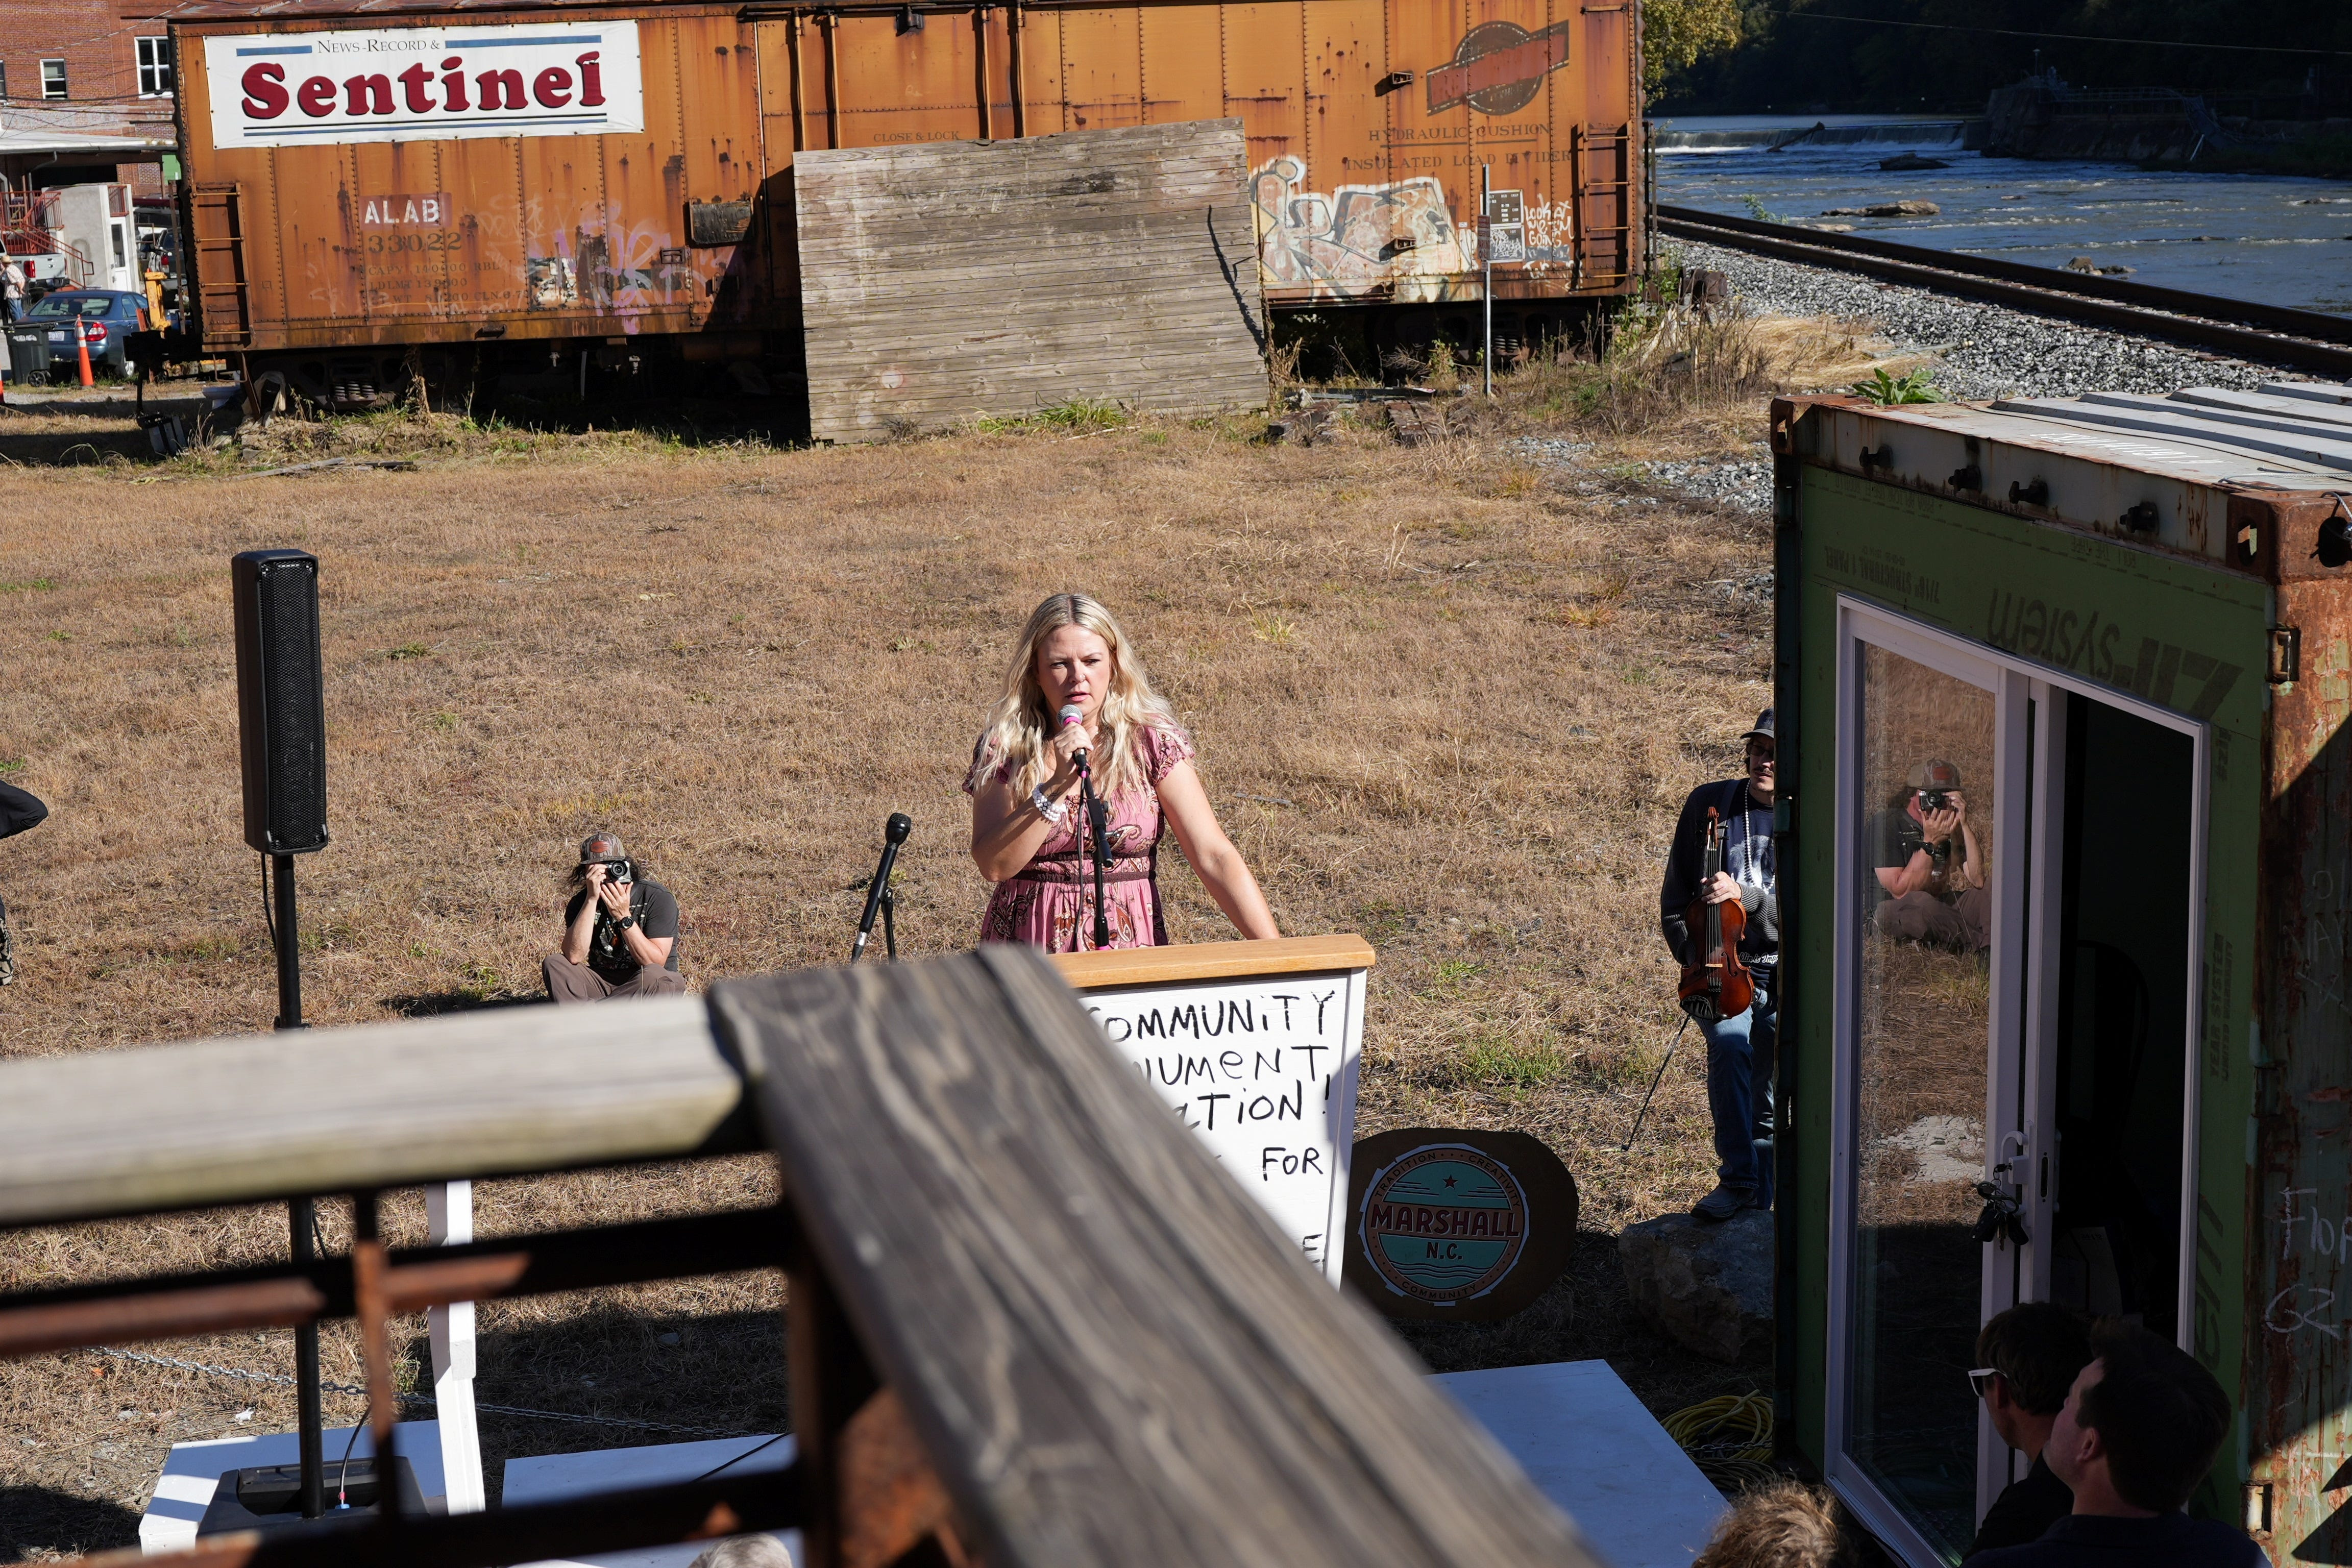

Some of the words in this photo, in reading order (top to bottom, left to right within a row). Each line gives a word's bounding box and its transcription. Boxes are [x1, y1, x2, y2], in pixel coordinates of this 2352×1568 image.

[430, 41, 439, 50] &
[241, 51, 606, 119] Sentinel
[874, 133, 912, 142] CLOSE
[916, 132, 924, 140] &
[928, 131, 960, 140] LOCK
[1368, 128, 1468, 141] HYDRAULIC
[1476, 124, 1550, 137] CUSHION
[1346, 156, 1441, 170] INSULATED
[1453, 154, 1496, 166] LOAD
[369, 232, 461, 254] 33022
[369, 264, 403, 276] CAPY
[474, 260, 500, 272] RBL
[1263, 1147, 1324, 1181] FOR
[1376, 1153, 1436, 1197] TRADITION
[1468, 1155, 1520, 1208] CREATIVITY
[1370, 1204, 1521, 1238] MARSHALL
[1426, 1242, 1463, 1260] N.C.
[1402, 1281, 1477, 1300] COMMUNITY
